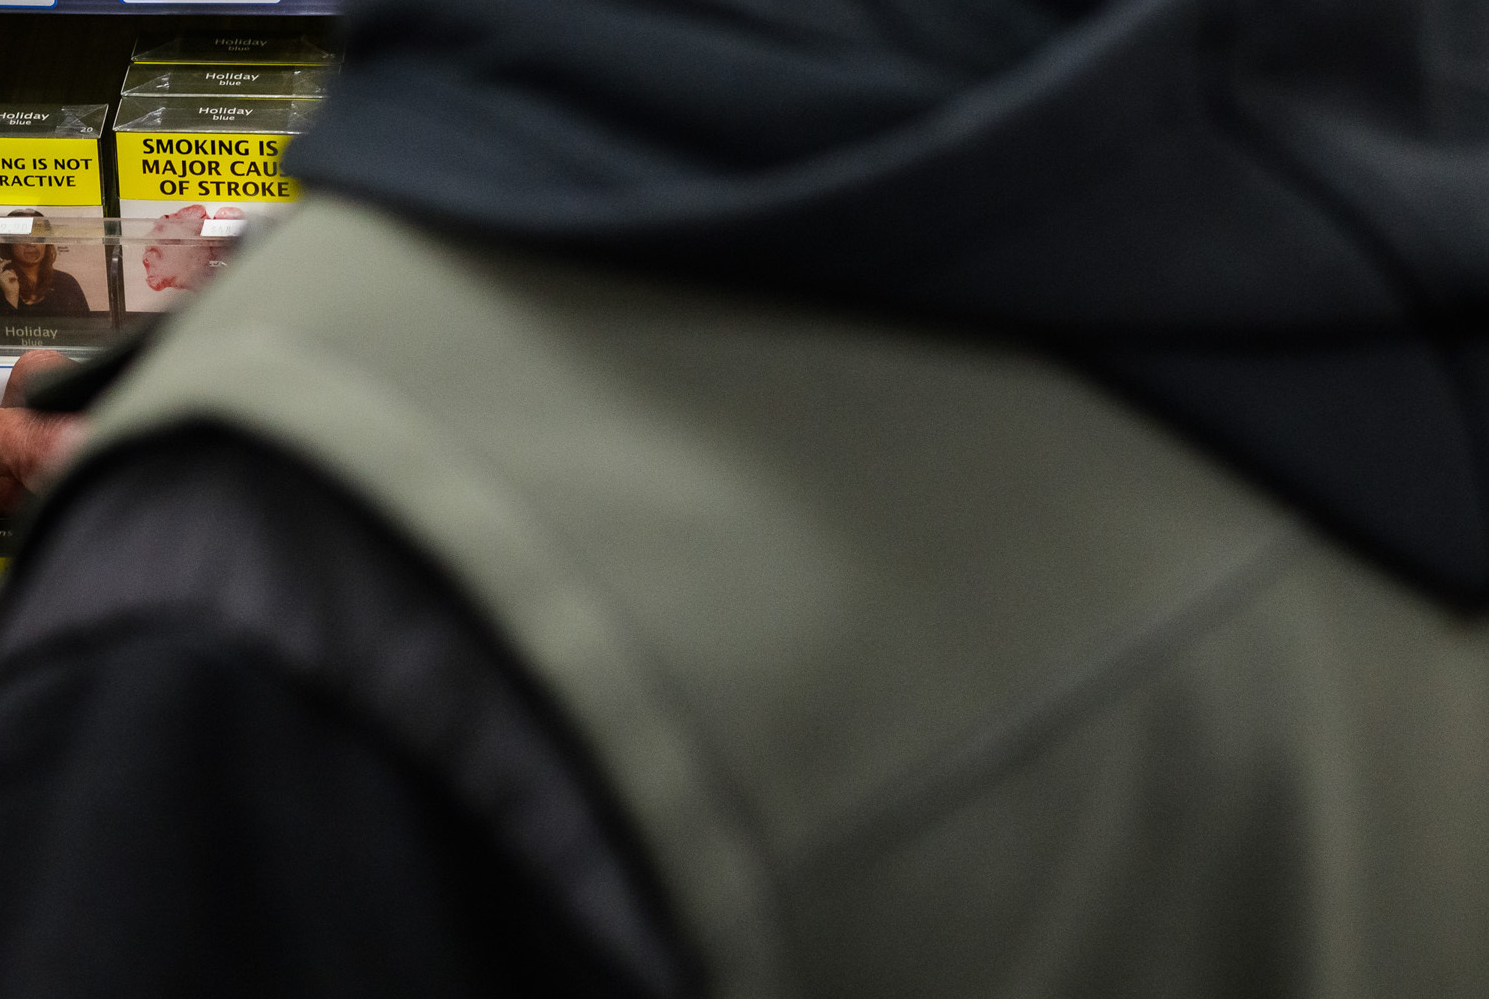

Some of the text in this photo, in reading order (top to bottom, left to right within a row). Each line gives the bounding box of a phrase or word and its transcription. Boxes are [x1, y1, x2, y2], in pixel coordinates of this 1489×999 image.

[206, 72, 260, 82] Holiday
[198, 106, 254, 116] Holiday
[9, 118, 32, 126] blue
[143, 139, 278, 156] SMOKING IS
[32, 158, 49, 170] IS
[54, 158, 93, 171] NOT
[142, 159, 221, 178] MAJOR
[160, 180, 290, 198] OF STROKE
